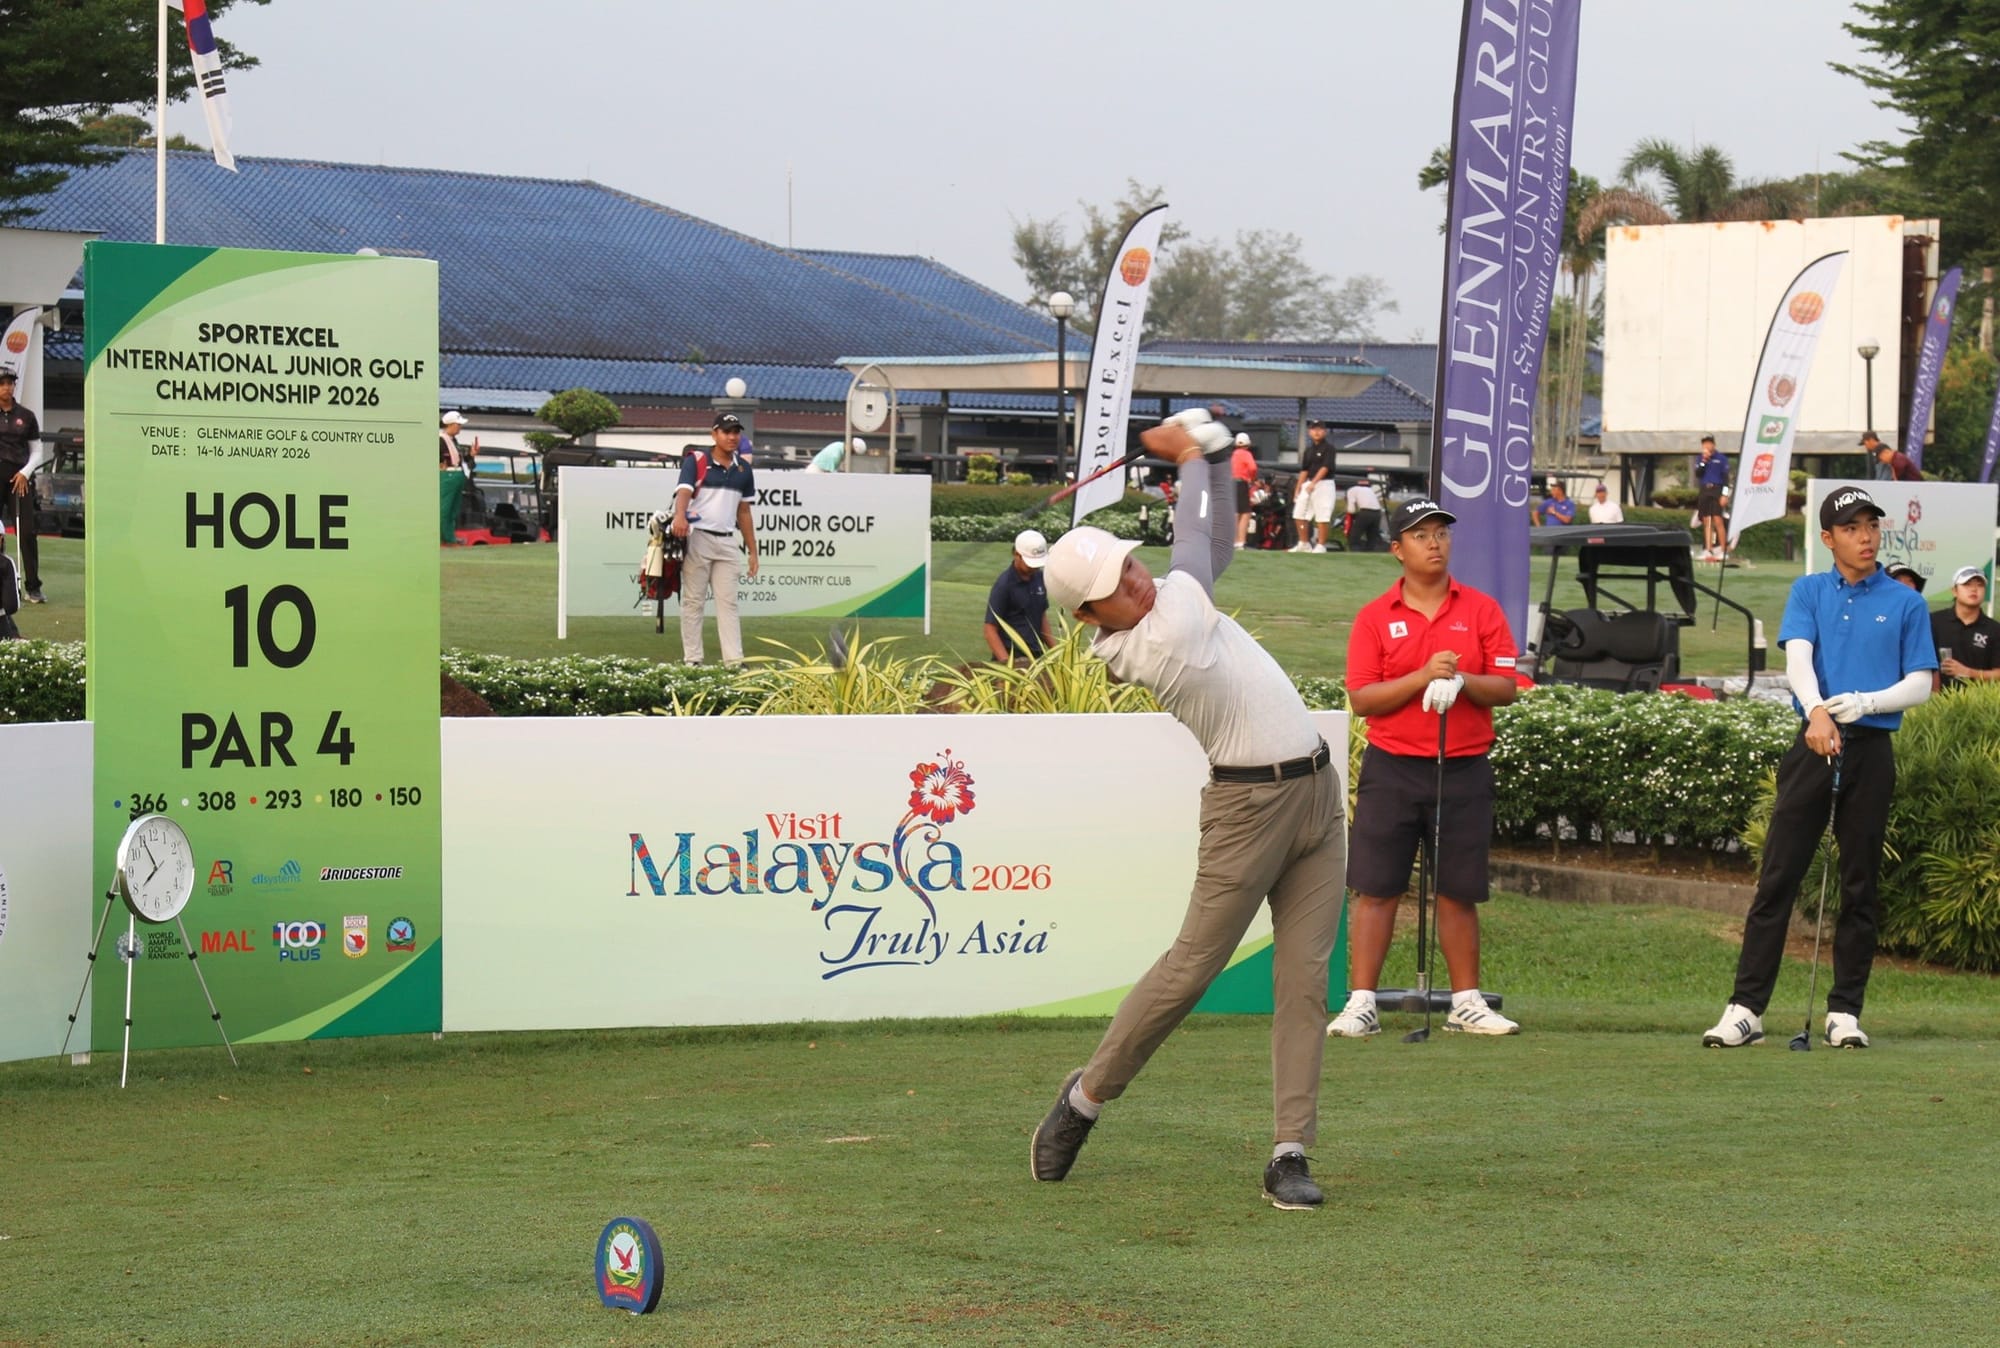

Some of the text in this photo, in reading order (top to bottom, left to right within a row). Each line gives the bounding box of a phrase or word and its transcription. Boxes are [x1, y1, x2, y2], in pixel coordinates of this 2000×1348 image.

[1502, 383, 1530, 507] GOLF
[1527, 0, 1554, 94] CLU
[1540, 240, 1557, 265] of
[198, 322, 339, 348] SPORTEXCEL
[106, 348, 425, 380] INTERNATIONAL JUNIOR GOLF
[156, 379, 380, 407] CHAMPIONSHIP 2026
[141, 426, 179, 439] VENUE
[197, 427, 262, 440] GLENMARIE
[266, 429, 297, 441] GOLF
[300, 430, 308, 442] &
[312, 431, 363, 443] COUNTRY
[366, 433, 395, 444] CLUB
[151, 444, 180, 456] DATE
[197, 446, 223, 457] 14-16
[227, 447, 278, 458] JANUARY
[282, 448, 310, 459] 2026
[186, 492, 349, 549] HOLE
[756, 514, 875, 532] JUNIOR GOLF
[792, 539, 836, 557] 2026
[738, 575, 766, 586] GOLF
[778, 576, 824, 586] COUNTRY
[827, 576, 852, 586] CLUB
[752, 592, 777, 602] 2026
[225, 585, 316, 668] 10
[182, 711, 355, 768] PAR 4
[130, 786, 422, 812] 366 308 293 180 150
[149, 829, 158, 842] 12
[765, 811, 842, 840] Visit
[131, 848, 140, 860] 10
[128, 866, 134, 878] 9
[321, 867, 402, 881] BRIDGESTONE
[626, 828, 1051, 911] Malaysia 2026
[148, 931, 174, 939] WORLD
[148, 938, 181, 946] AMATEUR
[202, 930, 255, 953] MAL
[277, 921, 321, 948] 100
[820, 904, 1049, 965] Truly Asia
[280, 948, 320, 962] PLUS
